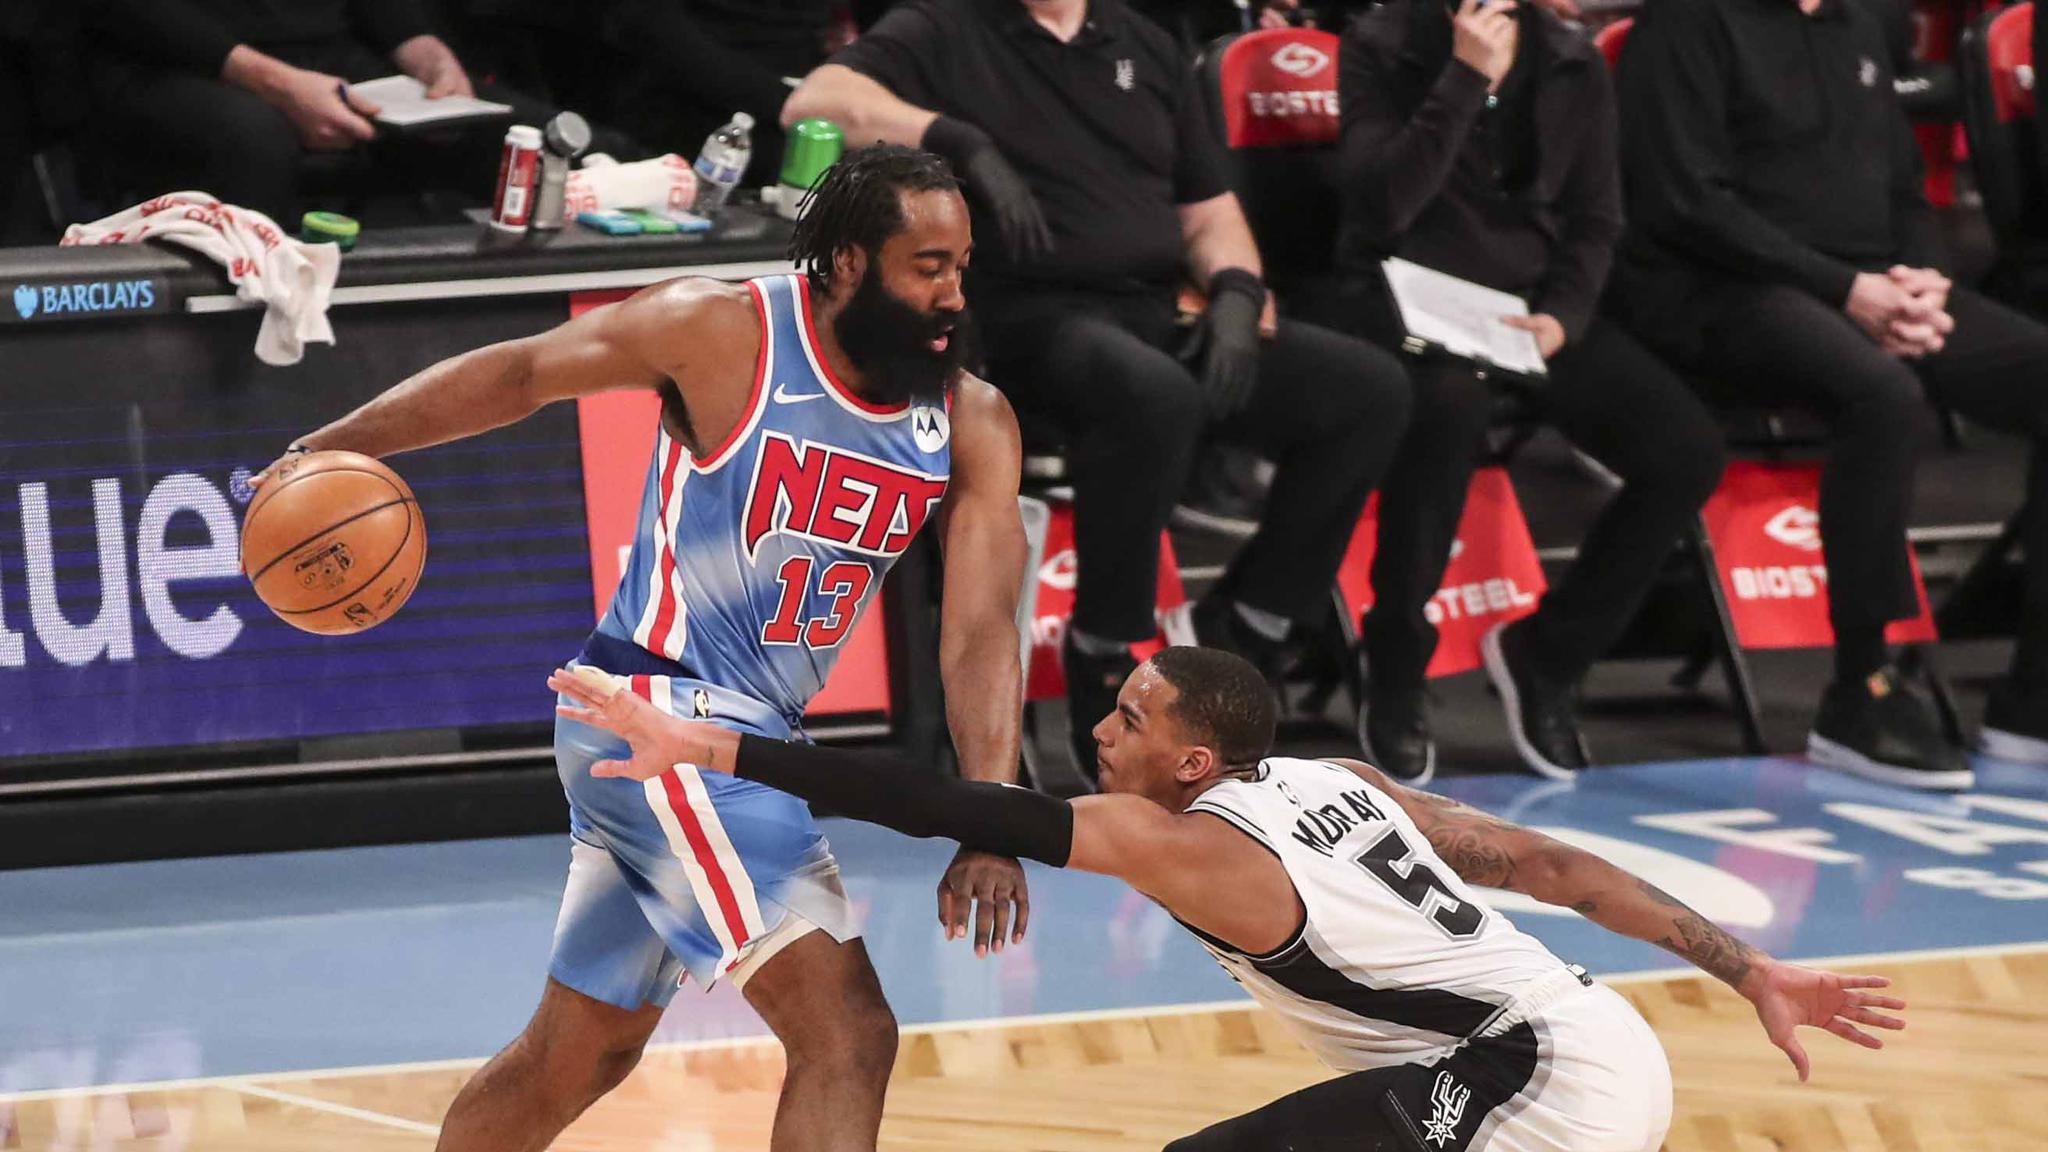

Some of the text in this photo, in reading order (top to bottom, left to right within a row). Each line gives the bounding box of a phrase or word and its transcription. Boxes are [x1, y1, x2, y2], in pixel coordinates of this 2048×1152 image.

[42, 280, 154, 315] BARCLAYS
[742, 430, 949, 567] NETS
[761, 555, 874, 650] 13
[1350, 823, 1490, 941] 5
